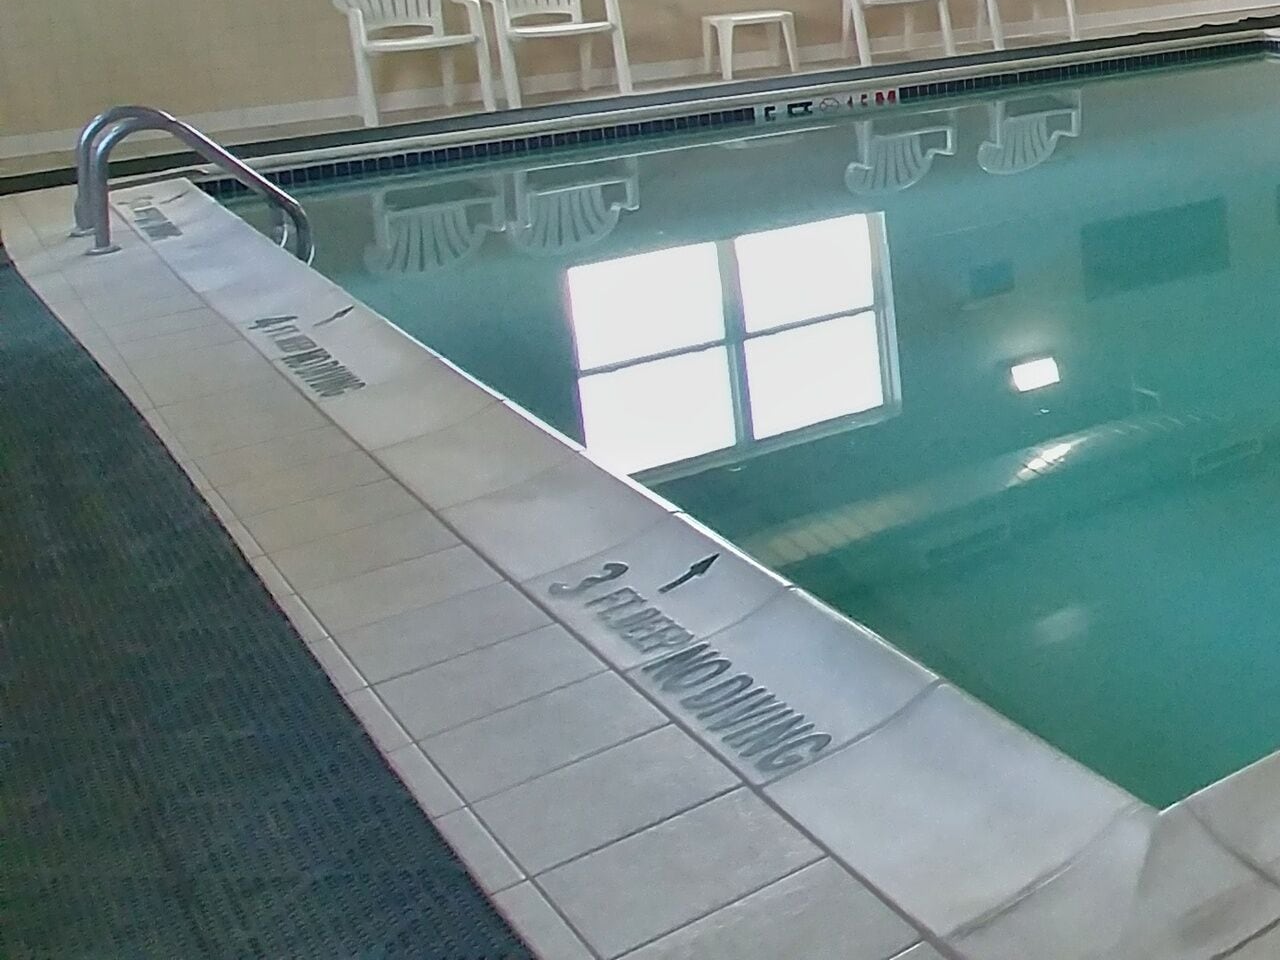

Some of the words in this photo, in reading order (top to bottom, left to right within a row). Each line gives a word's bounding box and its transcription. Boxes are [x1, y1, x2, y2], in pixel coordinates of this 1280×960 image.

[548, 562, 629, 597] 3
[641, 641, 732, 691] NO
[680, 673, 832, 771] DIVING
